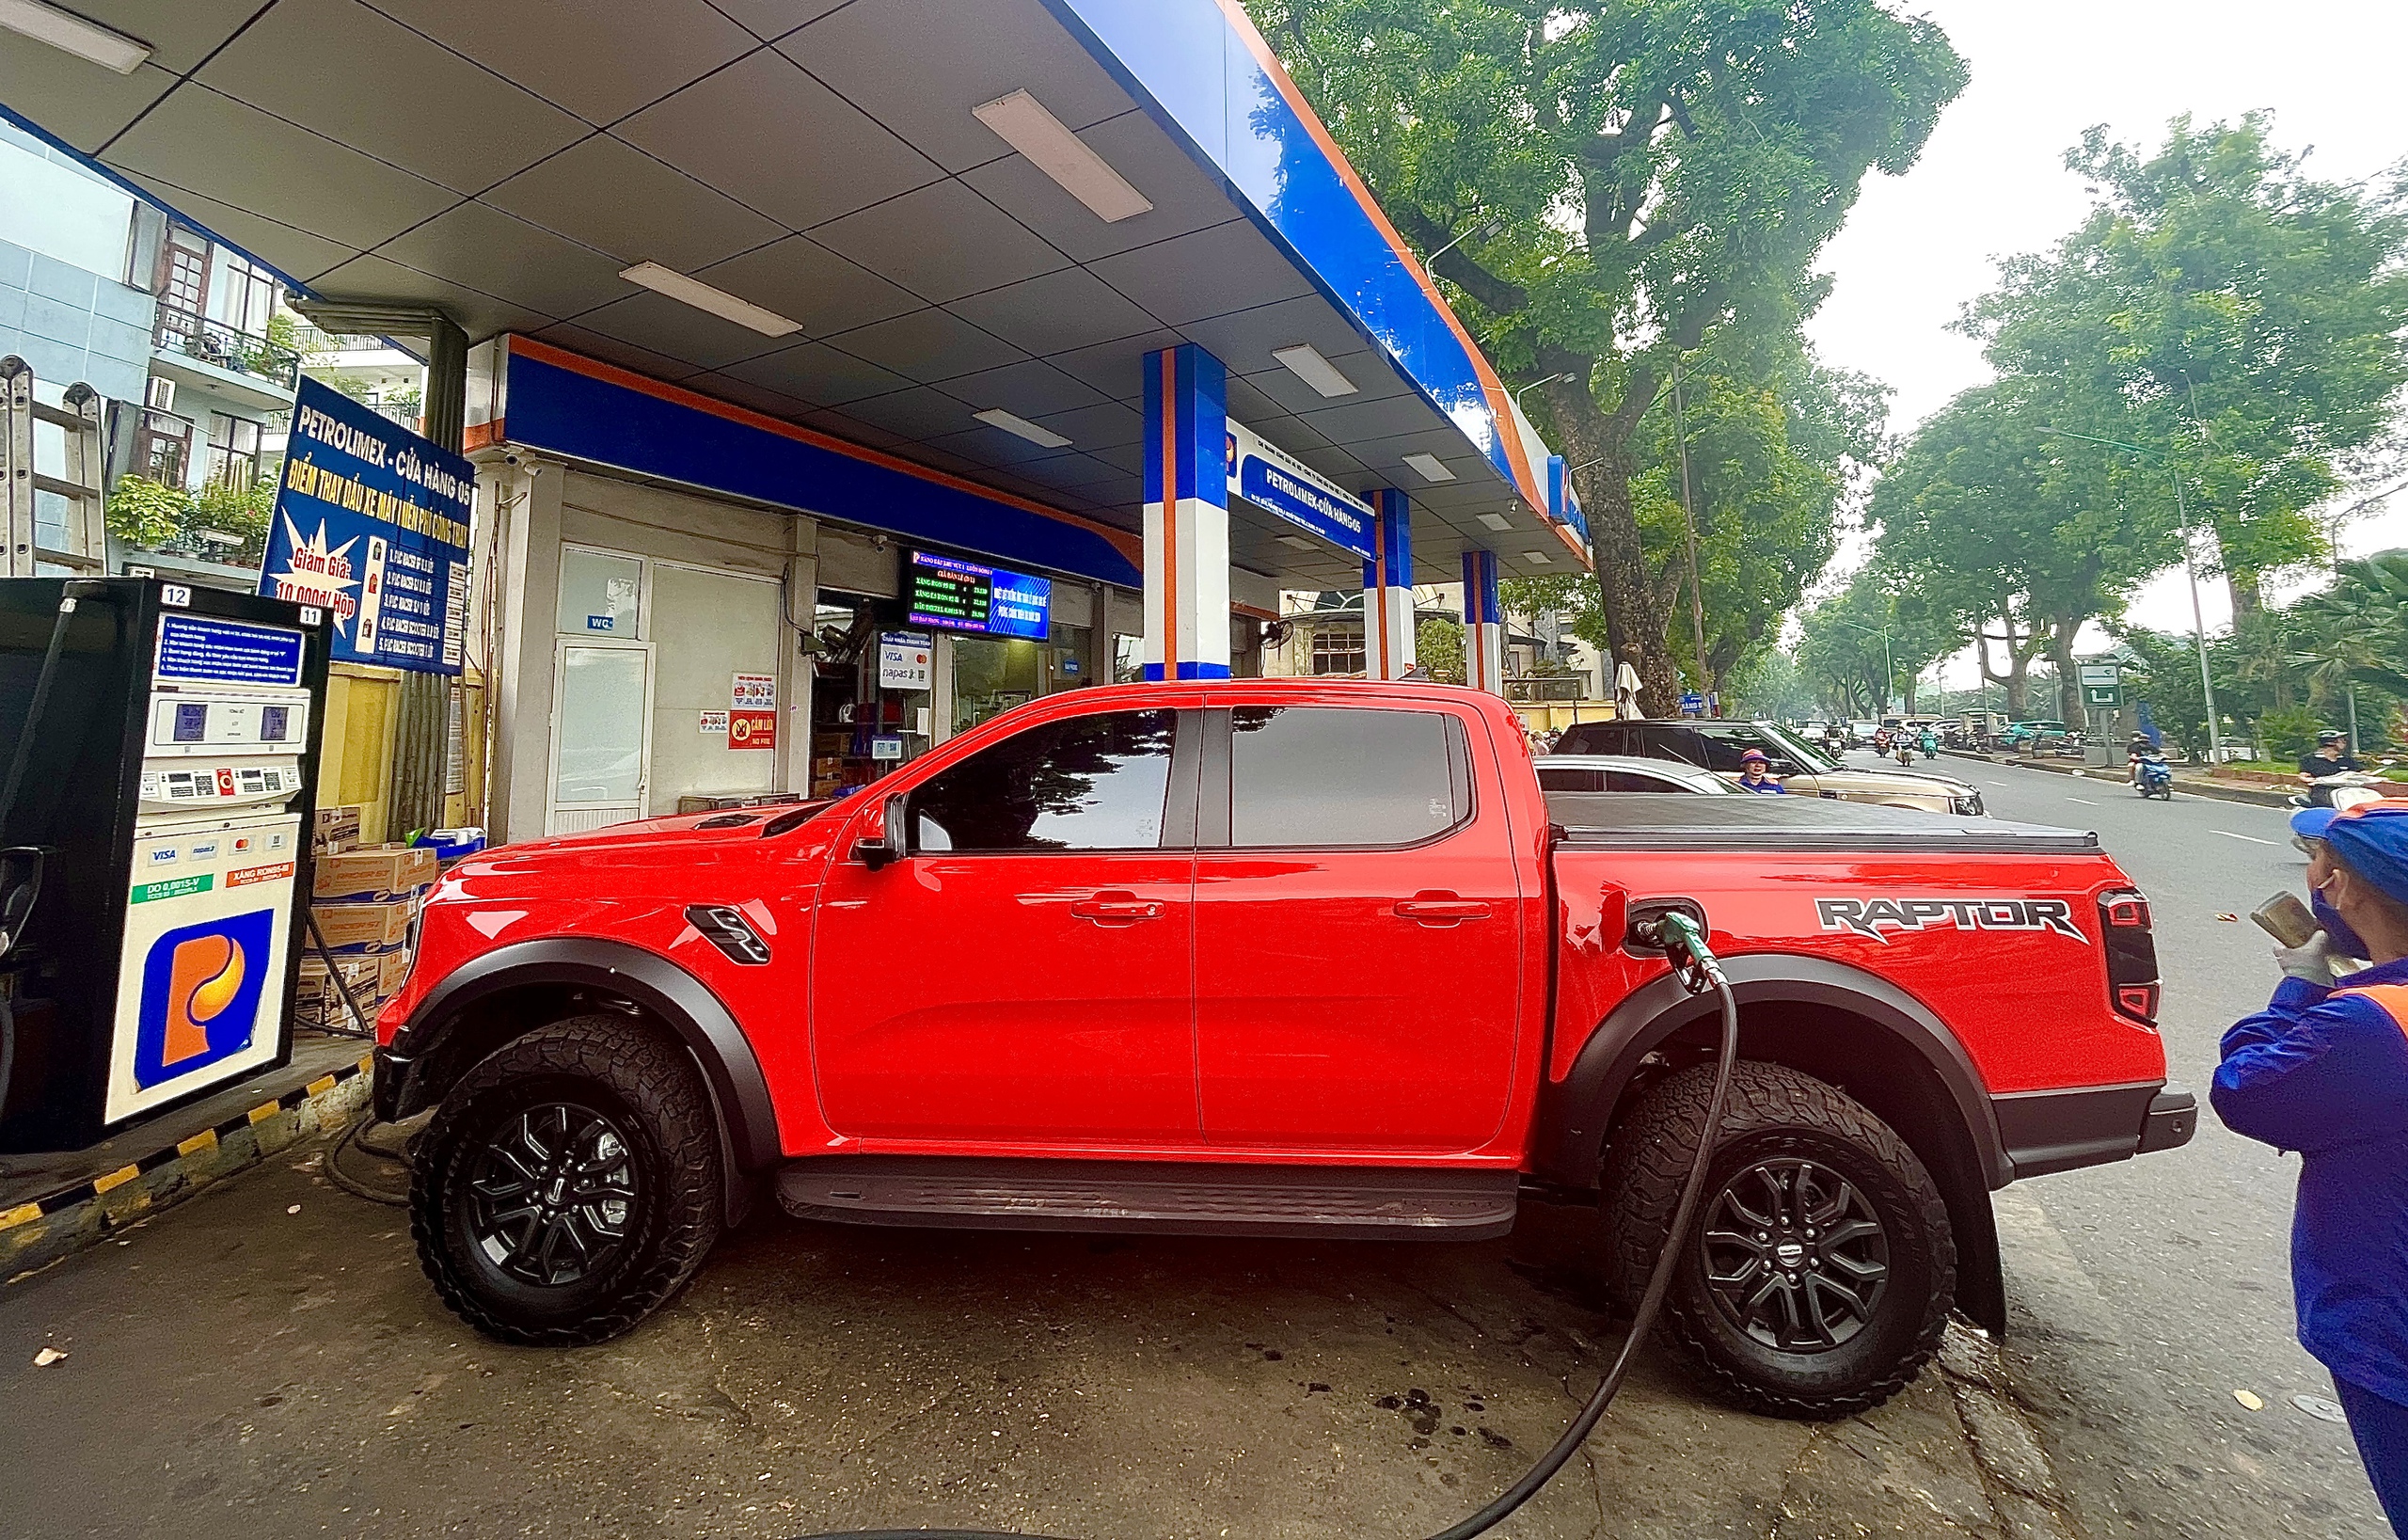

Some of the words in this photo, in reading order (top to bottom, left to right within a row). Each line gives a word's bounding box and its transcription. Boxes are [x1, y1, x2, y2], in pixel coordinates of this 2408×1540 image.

[298, 405, 387, 468] PETROLIMEX
[395, 447, 421, 484] CỬA
[423, 461, 456, 499] HÀNG
[457, 481, 470, 505] 05
[287, 452, 318, 497] ĐIỂM
[318, 468, 343, 505] THAY
[341, 472, 364, 512] DẦU
[363, 485, 377, 516] XE
[376, 489, 398, 524] MÁY
[1334, 508, 1352, 528] HÀNG
[1352, 517, 1361, 532] 05
[293, 548, 325, 573] Giảm
[167, 588, 186, 604] 12
[333, 593, 355, 619] Hộp
[304, 609, 317, 623] 11
[592, 617, 609, 628] WC
[884, 651, 903, 661] VISA
[152, 849, 176, 861] VISA
[233, 868, 256, 881] XĂNG
[148, 884, 162, 894] DO
[1813, 897, 2091, 945] RAPTOR
